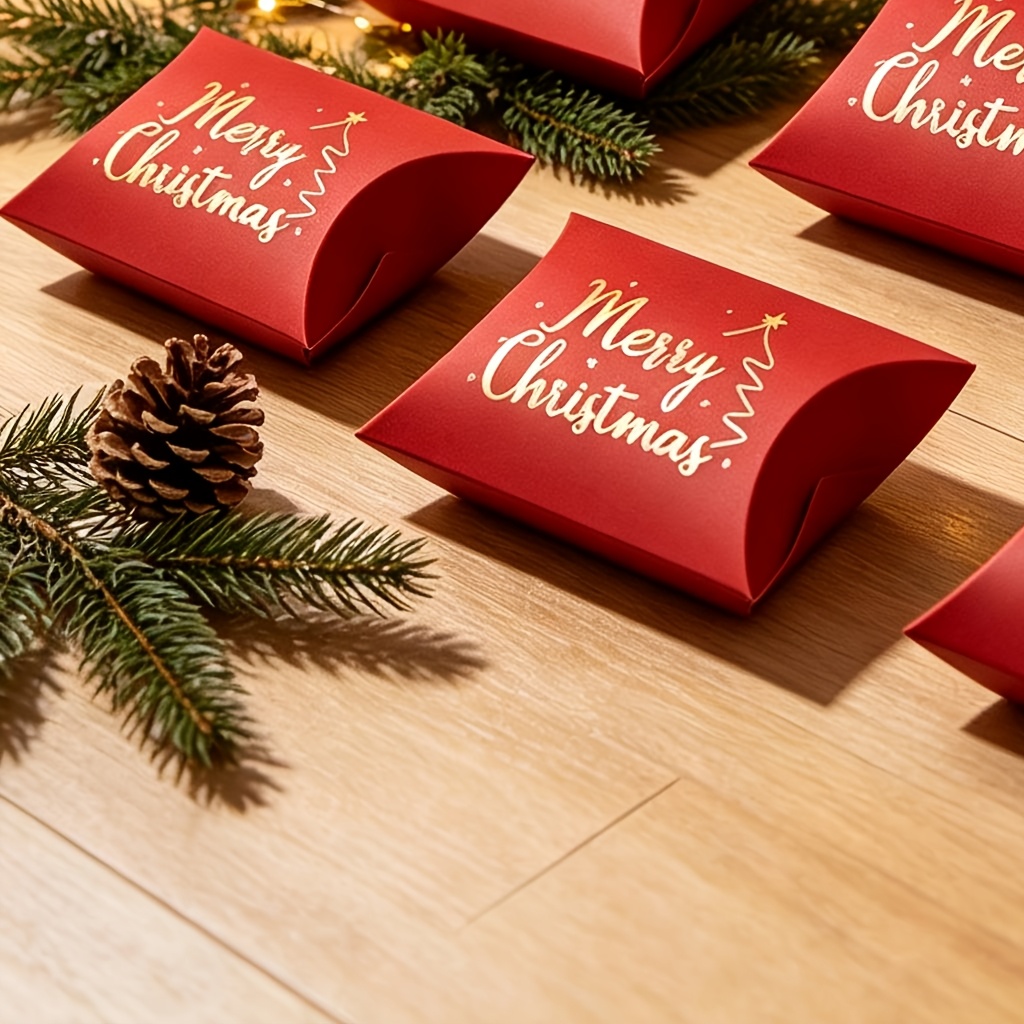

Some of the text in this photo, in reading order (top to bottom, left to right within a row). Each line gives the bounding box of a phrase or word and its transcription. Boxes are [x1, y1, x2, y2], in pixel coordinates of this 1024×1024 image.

[103, 121, 290, 243] Christmas
[158, 81, 307, 190] Merry
[481, 329, 713, 477] Christmas
[539, 279, 725, 412] Merry
